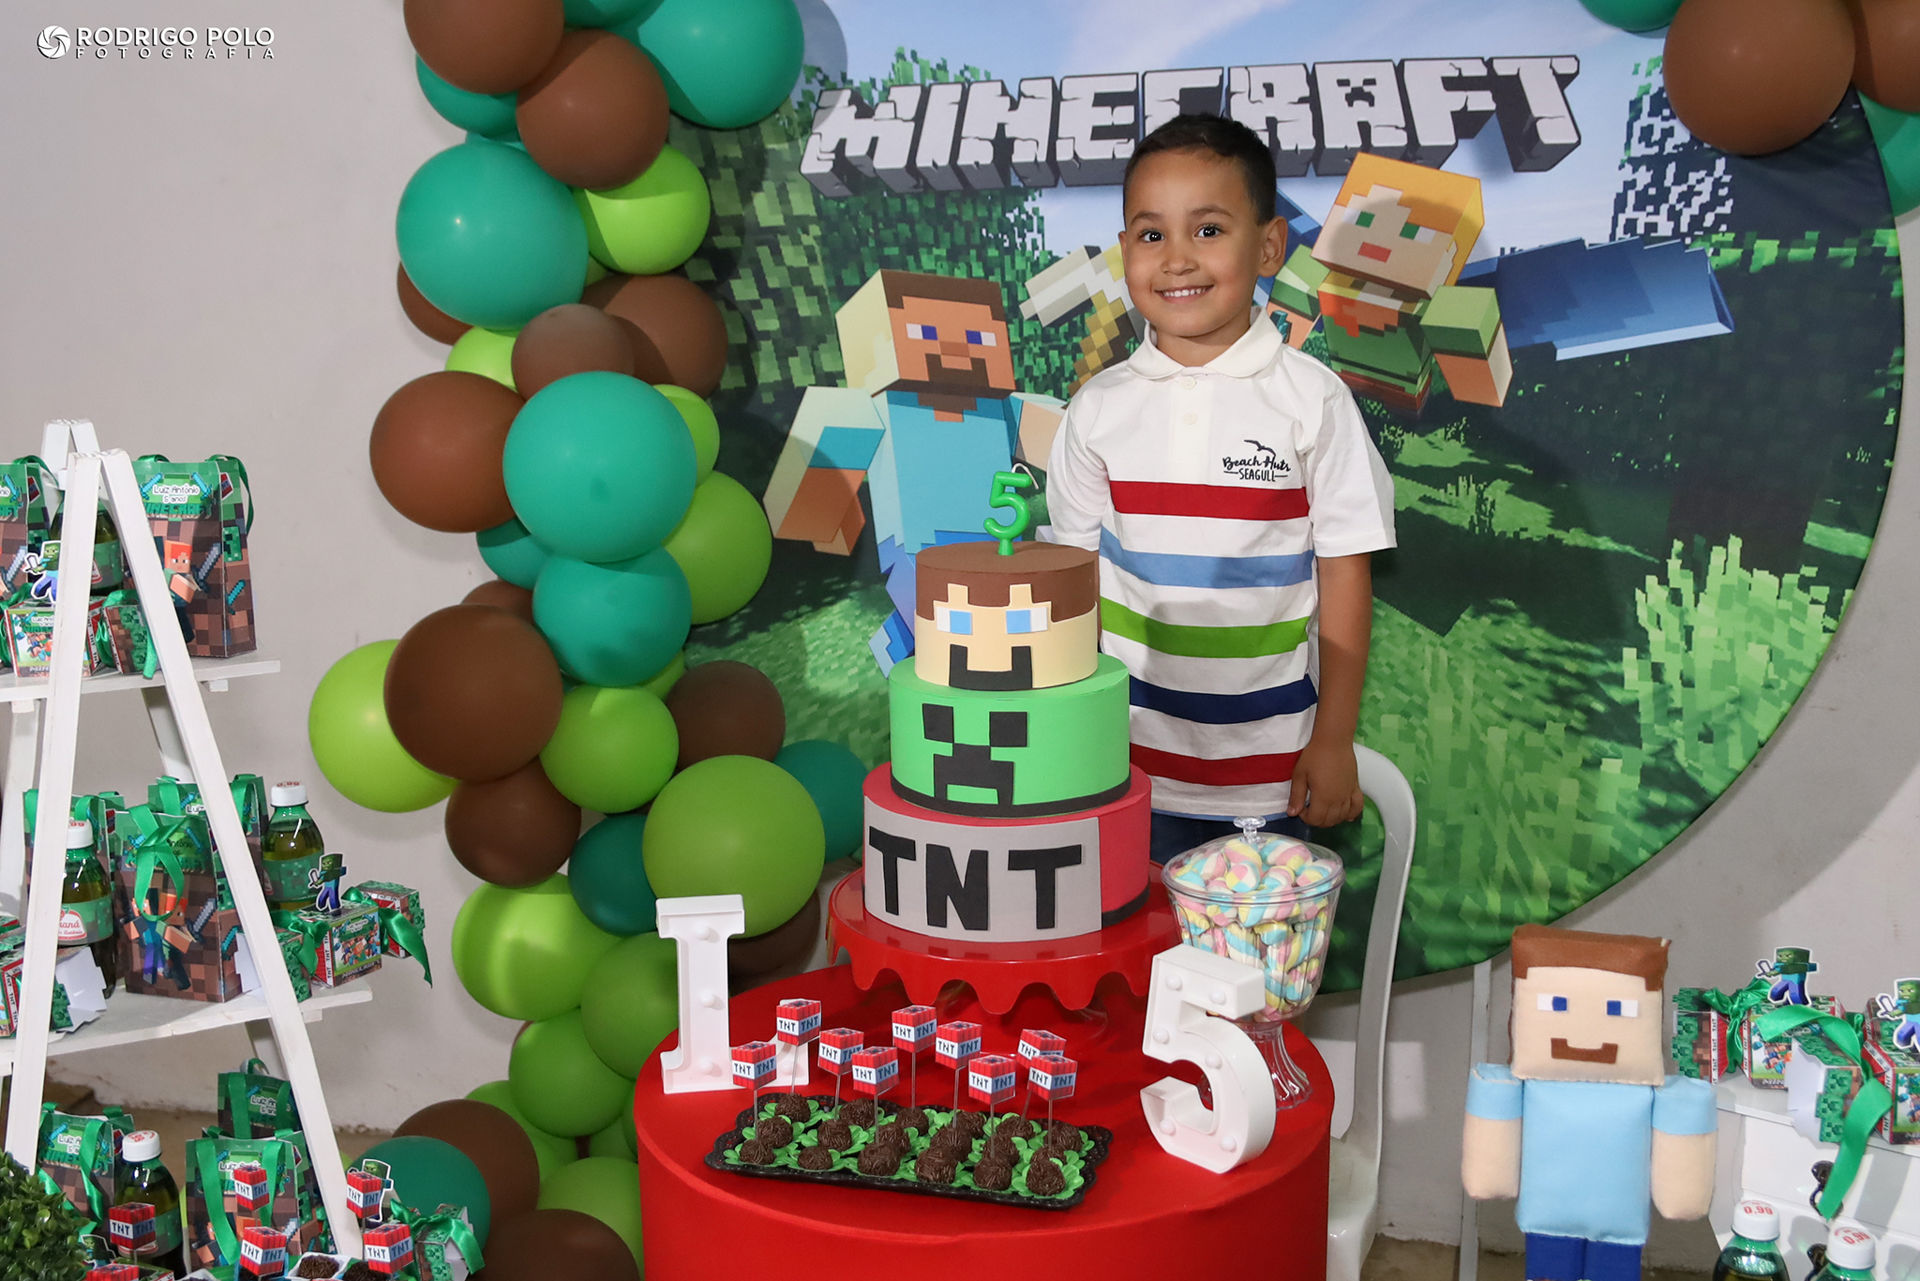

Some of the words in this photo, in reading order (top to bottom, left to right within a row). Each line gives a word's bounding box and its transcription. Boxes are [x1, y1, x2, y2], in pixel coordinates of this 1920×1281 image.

[801, 55, 1581, 197] MINECRAFT
[1222, 455, 1261, 470] Beach
[1261, 455, 1291, 472] Huts
[1239, 468, 1276, 482] SEAGULL
[983, 471, 1033, 541] 5
[868, 825, 1083, 931] TNT
[779, 1019, 796, 1033] TNT
[895, 1025, 911, 1037] TNT
[938, 1040, 955, 1055] TNT
[1140, 943, 1277, 1175] 5
[734, 1062, 752, 1076] TNT
[855, 1067, 873, 1081] TNT
[971, 1073, 989, 1089] TNT
[1031, 1069, 1049, 1085] TNT
[112, 1222, 130, 1236] TNT
[243, 1243, 260, 1260] TNT
[367, 1247, 386, 1260] TNT
